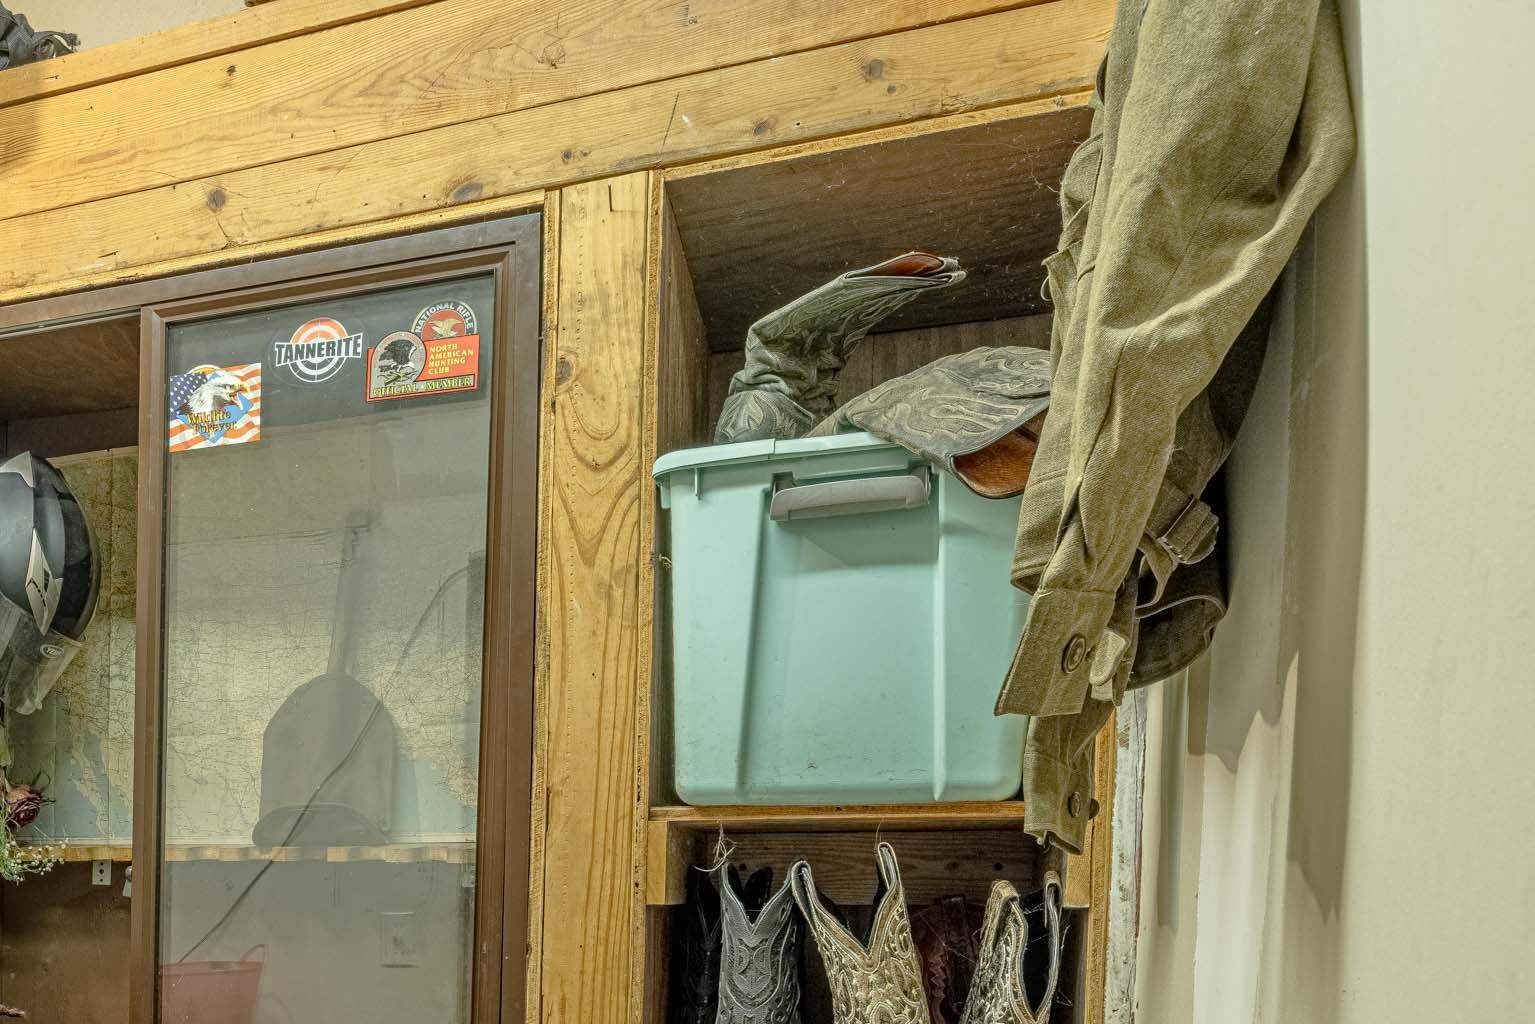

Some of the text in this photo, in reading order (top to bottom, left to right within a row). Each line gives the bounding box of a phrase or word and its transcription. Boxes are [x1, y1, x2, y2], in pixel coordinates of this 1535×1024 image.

[415, 302, 474, 333] NATIONAL RIFLE
[275, 334, 362, 366] TANNERITE
[429, 343, 458, 353] NORTH
[429, 348, 474, 360] AMERICAN
[429, 357, 466, 368] HUNTING
[428, 366, 449, 375] CLUB
[373, 377, 471, 397] OFFICIAL MEMBER
[187, 409, 231, 424] Wildlife
